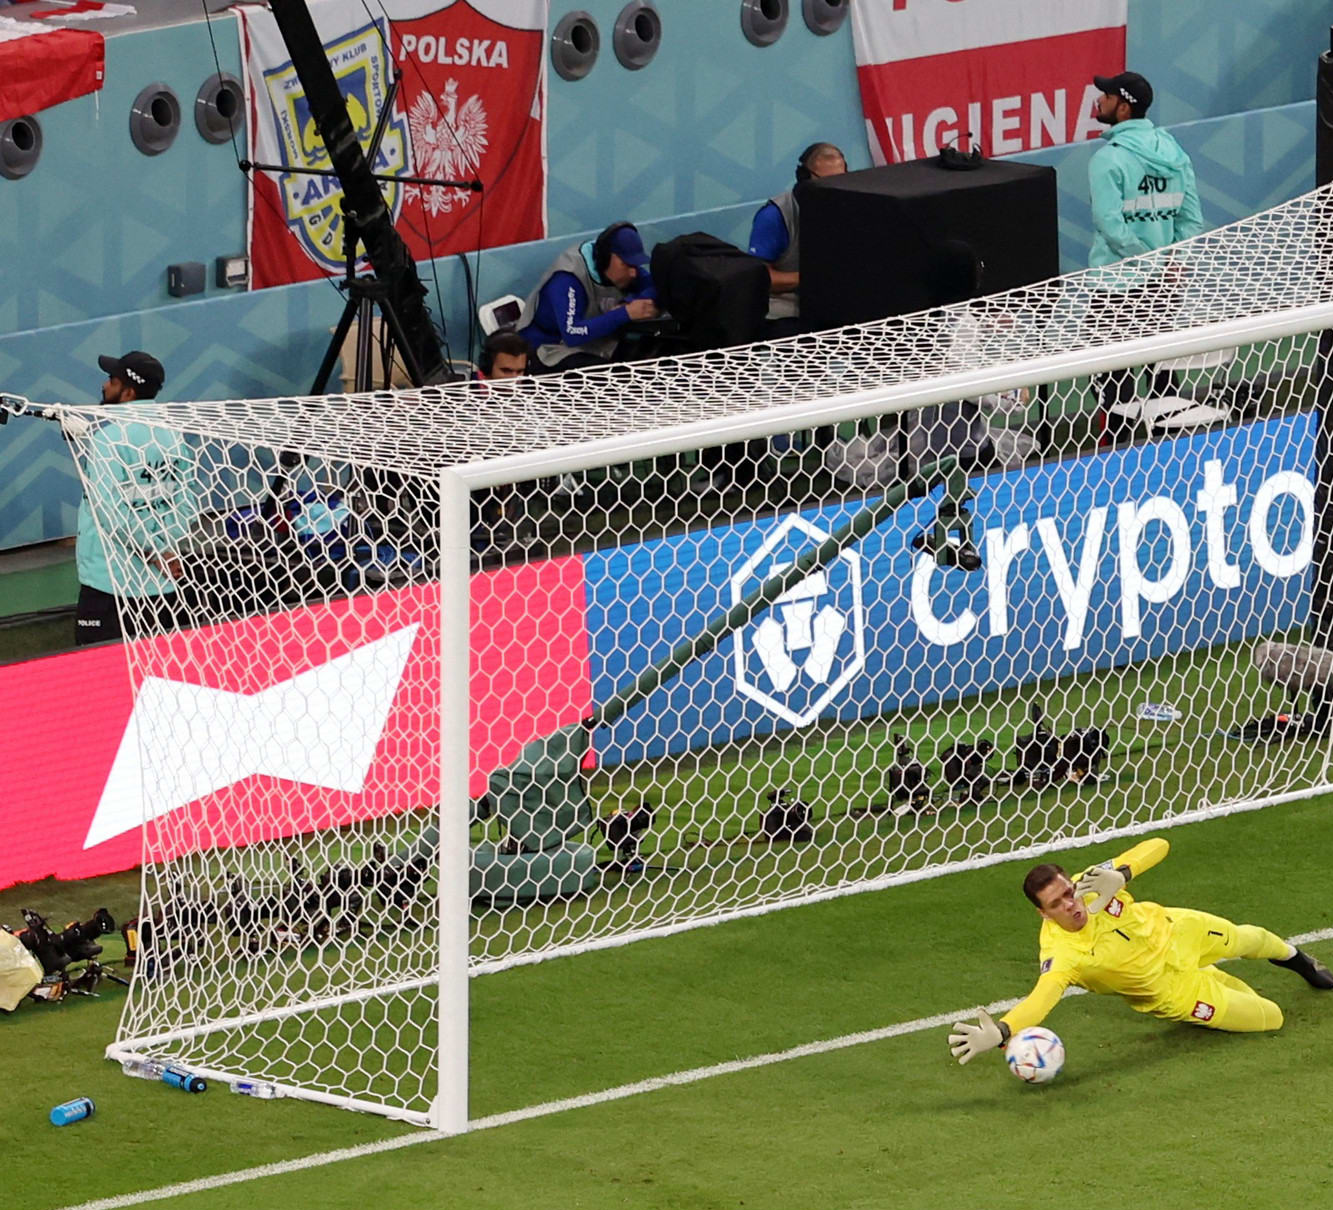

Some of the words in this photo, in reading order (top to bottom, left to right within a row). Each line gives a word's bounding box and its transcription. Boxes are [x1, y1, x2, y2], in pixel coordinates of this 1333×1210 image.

[342, 42, 368, 63] KLUB
[399, 33, 509, 69] POLSKA
[78, 619, 101, 627] POLICE
